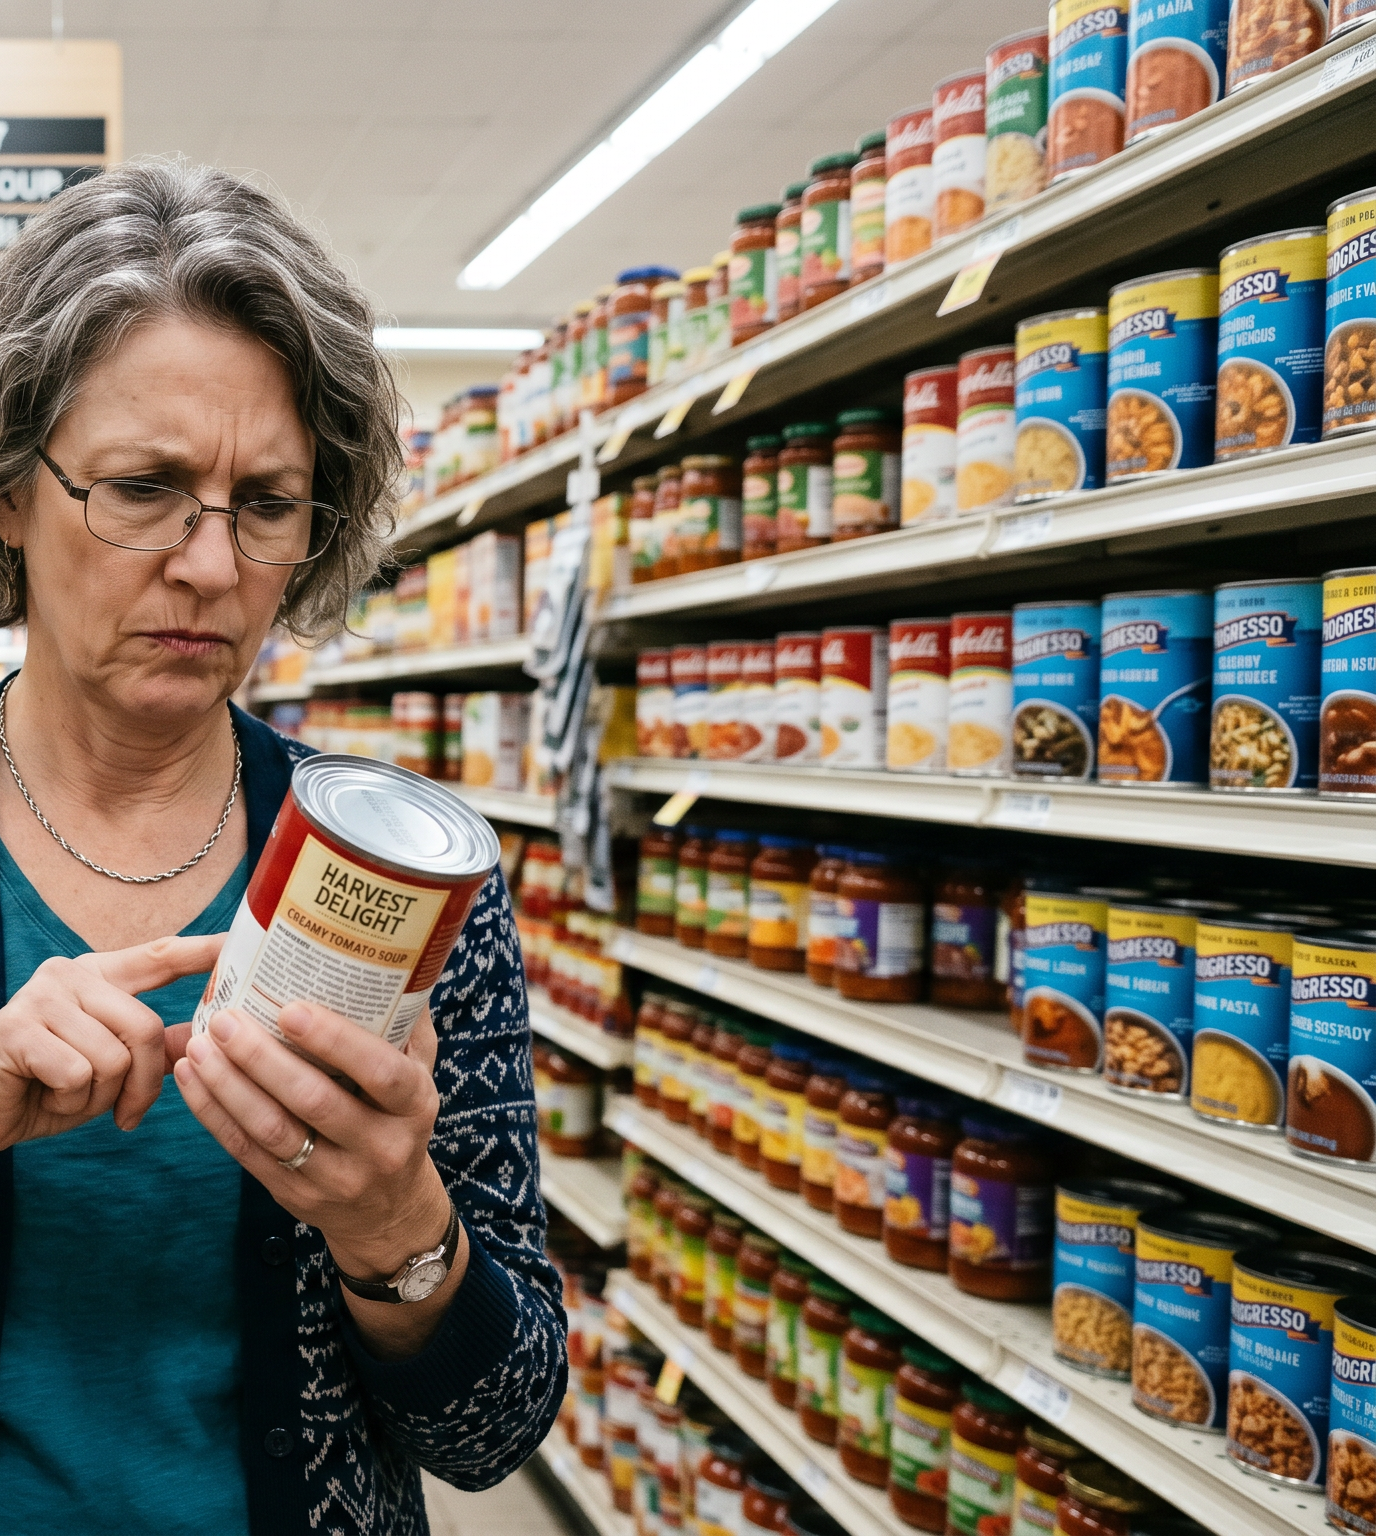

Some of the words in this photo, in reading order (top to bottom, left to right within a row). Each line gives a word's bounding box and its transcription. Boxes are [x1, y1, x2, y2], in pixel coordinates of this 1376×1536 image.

[314, 886, 406, 936] DELIGHT
[321, 863, 418, 916] HARVEST
[287, 908, 329, 938] CREAMY
[329, 934, 376, 958] TOMATO
[378, 950, 408, 965] SOUP
